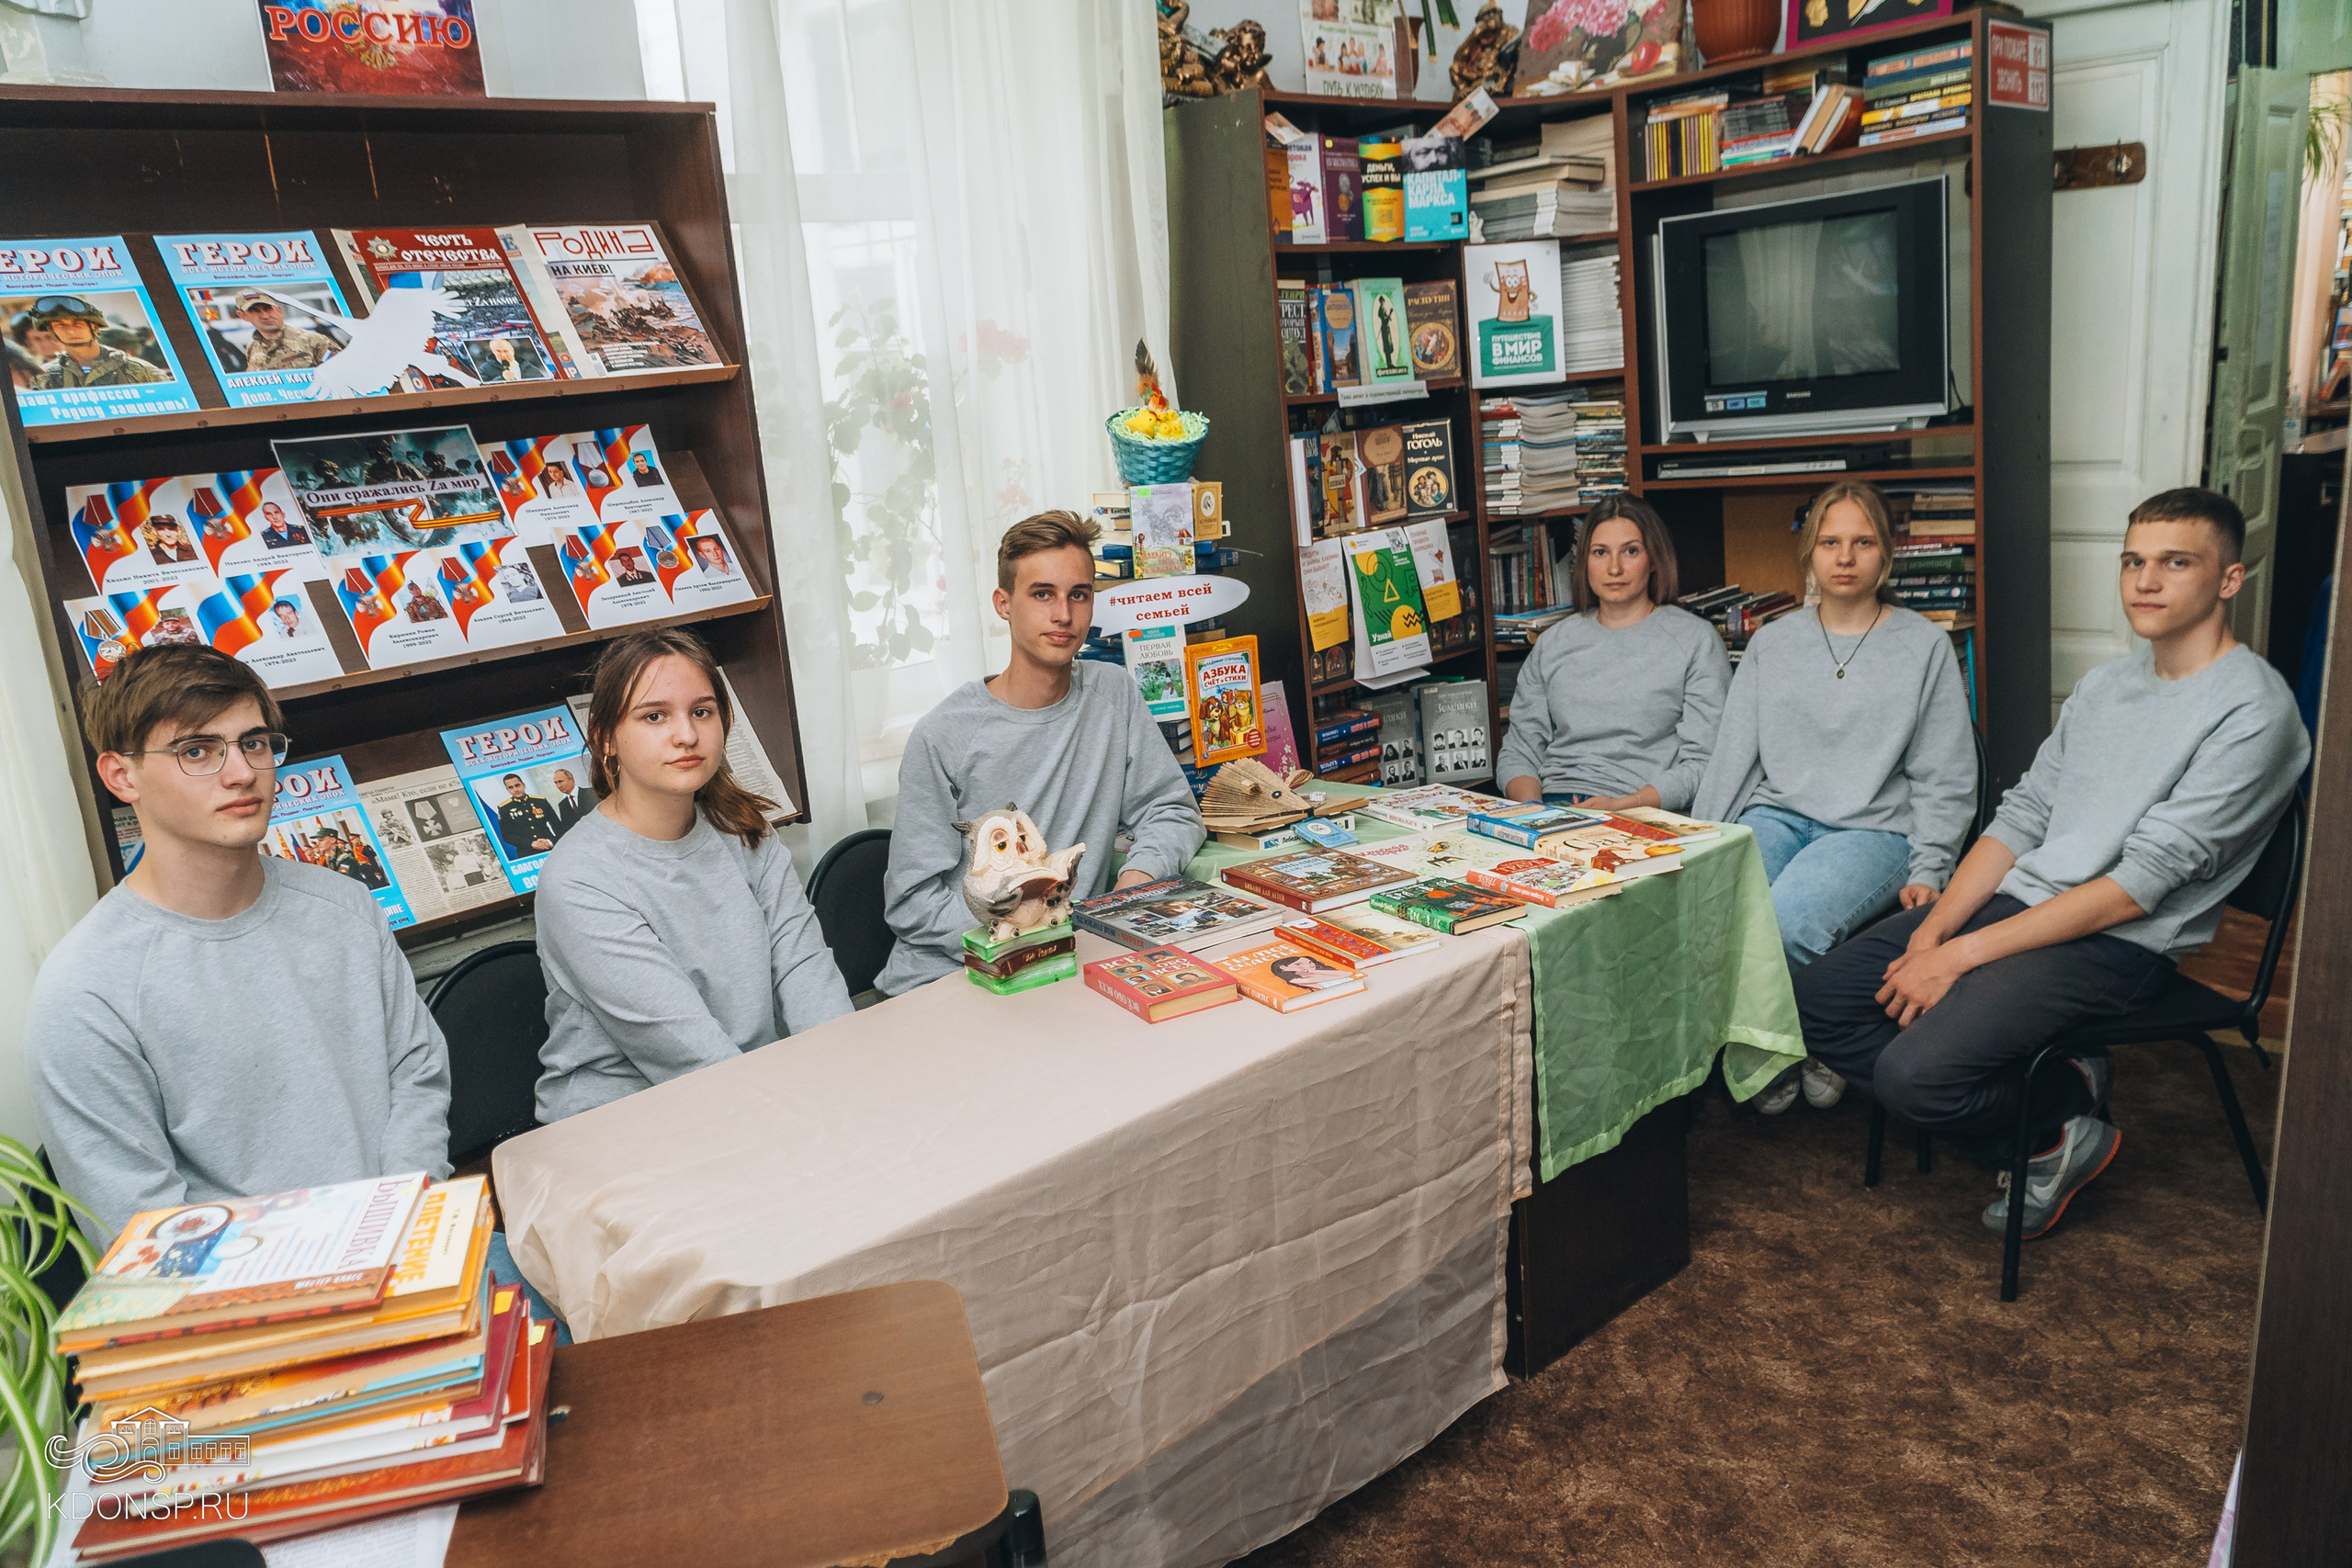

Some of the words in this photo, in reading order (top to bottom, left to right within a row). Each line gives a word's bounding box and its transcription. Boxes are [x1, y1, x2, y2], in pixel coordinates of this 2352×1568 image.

[265, 6, 471, 49] РОССИЮ
[1408, 182, 1446, 196] КАРЛА
[1408, 192, 1456, 209] МАРКСА
[171, 239, 313, 266] ГЕРОИ
[401, 248, 503, 263] ОТЕЧЕСТВА
[551, 265, 571, 276] НА
[572, 264, 613, 275] КИЕВ!
[1492, 343, 1503, 357] В
[1505, 339, 1543, 356] МИР
[1492, 353, 1544, 365] ФИНАНСОВ
[227, 373, 283, 389] АЛЕКСЕЙ
[1407, 436, 1443, 451] ГОГОЛЬ
[306, 491, 342, 505] Они
[345, 483, 425, 502] сражались
[451, 476, 481, 491] мир
[1109, 590, 1172, 607] #читаем
[1178, 582, 1213, 598] всей
[1136, 604, 1190, 621] семьей
[1371, 631, 1392, 643] Узнай
[1139, 641, 1171, 652] ПЕРВАЯ
[1139, 649, 1174, 660] ЛЮБОВЬ
[1203, 664, 1247, 682] АЗБУКА
[1225, 674, 1247, 682] СТИХИ
[455, 716, 571, 761] ГЕРОИ
[371, 793, 400, 806] «Мама!
[401, 789, 419, 800] Кто,
[420, 784, 436, 795] если
[437, 784, 448, 793] не
[1272, 858, 1322, 872] БИБЛИЯ
[1080, 878, 1183, 908] КУБАНЬ
[1244, 882, 1261, 893] БИБЛИЯ
[1261, 888, 1271, 897] ДЛЯ
[1272, 891, 1285, 902] ДЕТЕЙ
[1076, 915, 1103, 933] ГОРДОСТЬ
[1103, 925, 1116, 937] МОЯ
[1120, 932, 1144, 949] КУБАНЬ
[1156, 957, 1189, 969] ОБО
[1222, 953, 1250, 966] ТЫ
[1228, 948, 1302, 972] СЧАСТЬЕ
[1150, 962, 1195, 976] ВСЕХ
[1097, 979, 1114, 997] ВСЕХ
[1114, 990, 1126, 1004] ОБО
[396, 1192, 447, 1286] ПЛЕТЕНИЕ
